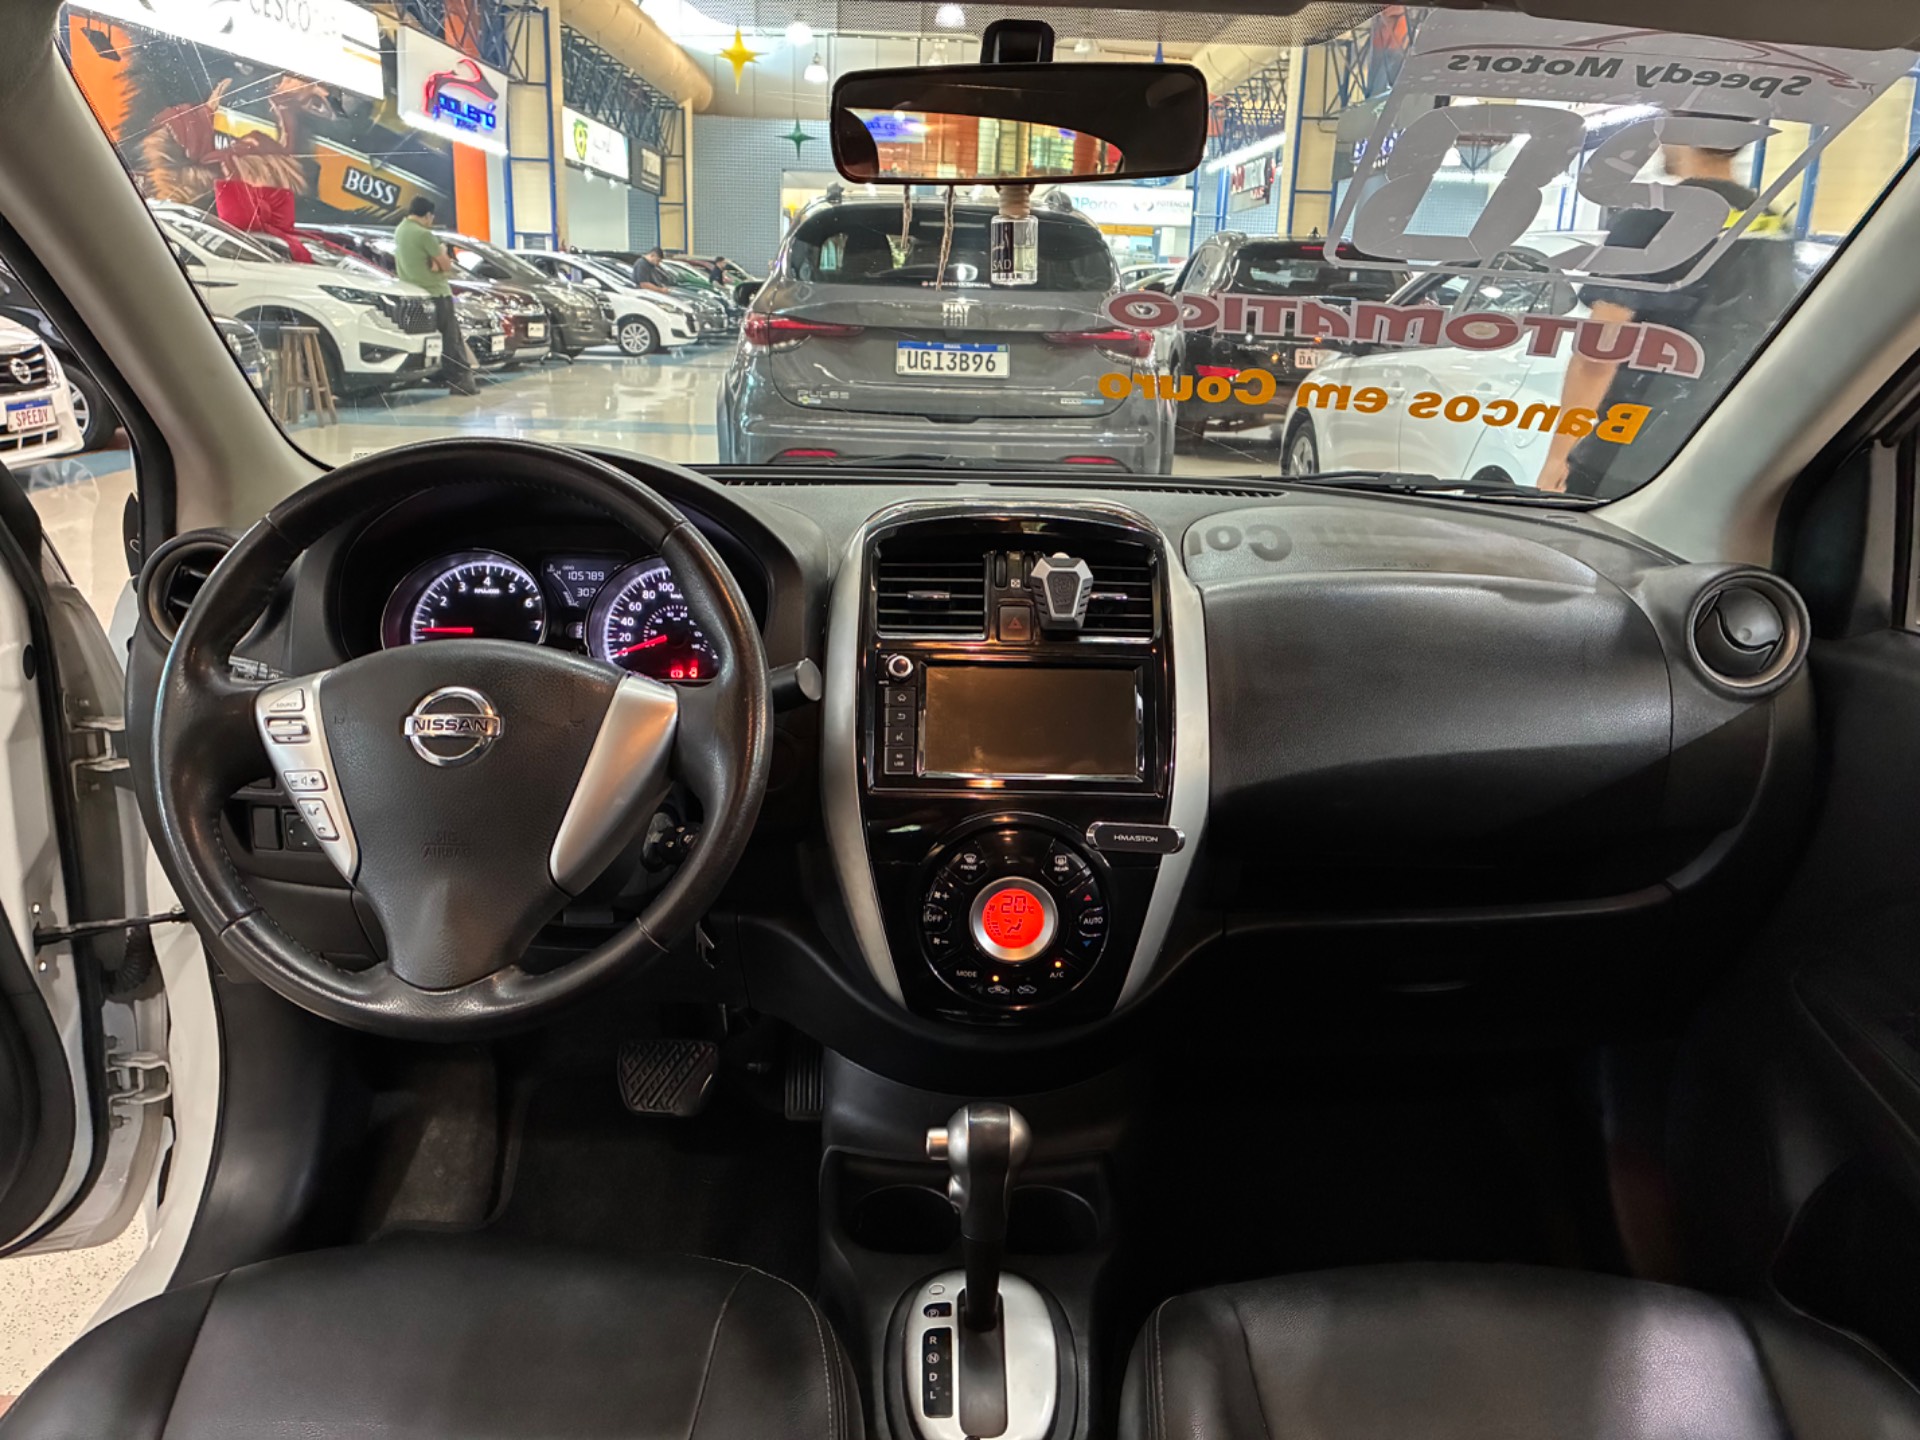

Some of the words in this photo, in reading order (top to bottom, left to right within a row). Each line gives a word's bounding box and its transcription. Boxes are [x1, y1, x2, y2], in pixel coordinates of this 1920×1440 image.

[345, 169, 397, 205] BOSS
[1081, 196, 1118, 210] Porto
[906, 350, 997, 372] UGI3B96
[15, 408, 48, 427] SPEEDY
[568, 571, 604, 581] 105789
[483, 577, 491, 586] 4
[458, 582, 466, 592] 3
[508, 583, 516, 593] 5
[658, 583, 675, 592] 100
[642, 590, 656, 599] 80
[440, 597, 448, 607] 2
[629, 602, 642, 611] 60
[430, 619, 435, 629] 1
[534, 621, 541, 630] 7
[620, 617, 634, 626] 40
[619, 633, 631, 642] 20
[413, 718, 488, 732] NISSAN
[927, 914, 942, 923] OFF
[1083, 916, 1103, 925] AUTO
[956, 969, 978, 978] MODE
[1049, 970, 1064, 979] A/C
[929, 1336, 938, 1345] R
[929, 1353, 937, 1362] N
[929, 1373, 938, 1381] D
[929, 1391, 937, 1399] L
